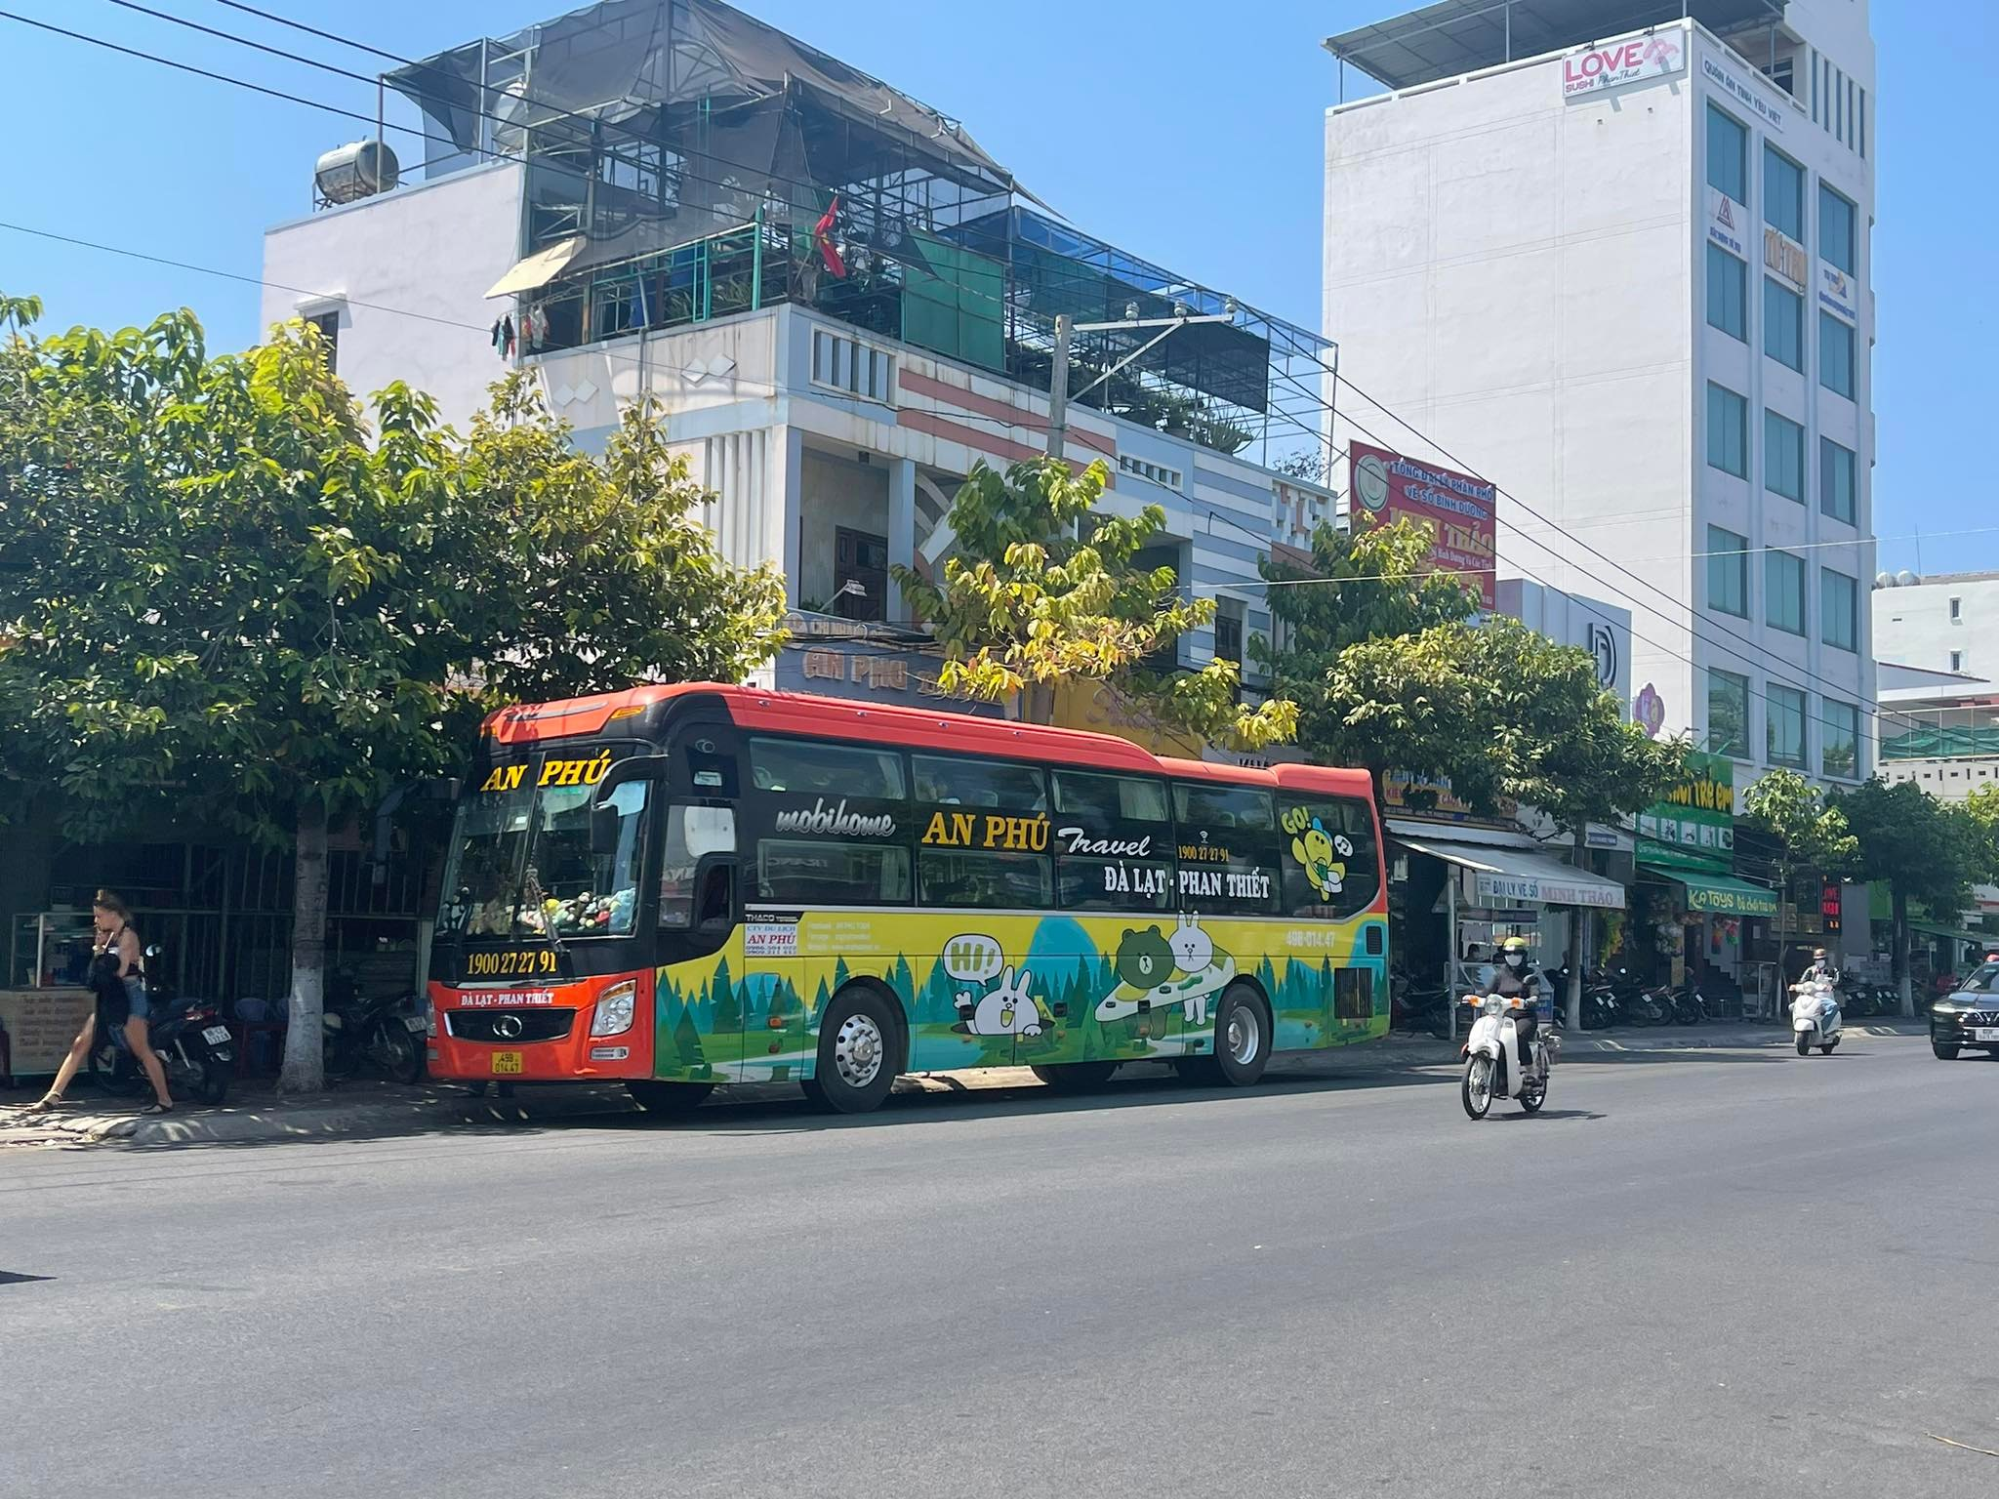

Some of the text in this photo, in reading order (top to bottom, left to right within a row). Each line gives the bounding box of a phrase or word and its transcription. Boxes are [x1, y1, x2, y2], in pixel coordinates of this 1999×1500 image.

[1565, 42, 1644, 83] LOVE
[1566, 79, 1595, 93] SUSHI
[1436, 493, 1457, 510] BÌNH
[803, 647, 844, 680] AN
[480, 749, 611, 792] AN PHÚ
[775, 797, 897, 838] mobihome
[921, 811, 1051, 851] AN PHÚ
[1281, 806, 1312, 835] GO!
[1057, 827, 1150, 857] Travel
[1178, 845, 1230, 862] 1900 27 27 91
[1104, 860, 1270, 898] ĐÀ LẠT PHAN THIẾT
[1541, 885, 1576, 903] MINH
[745, 913, 775, 922] THACO
[747, 934, 766, 944] AN
[768, 932, 797, 944] PHÚ
[466, 949, 556, 975] 1900 27 27 91
[950, 942, 995, 974] HI!
[461, 987, 554, 1008] ĐÀ LẠT PHAN THIẾT
